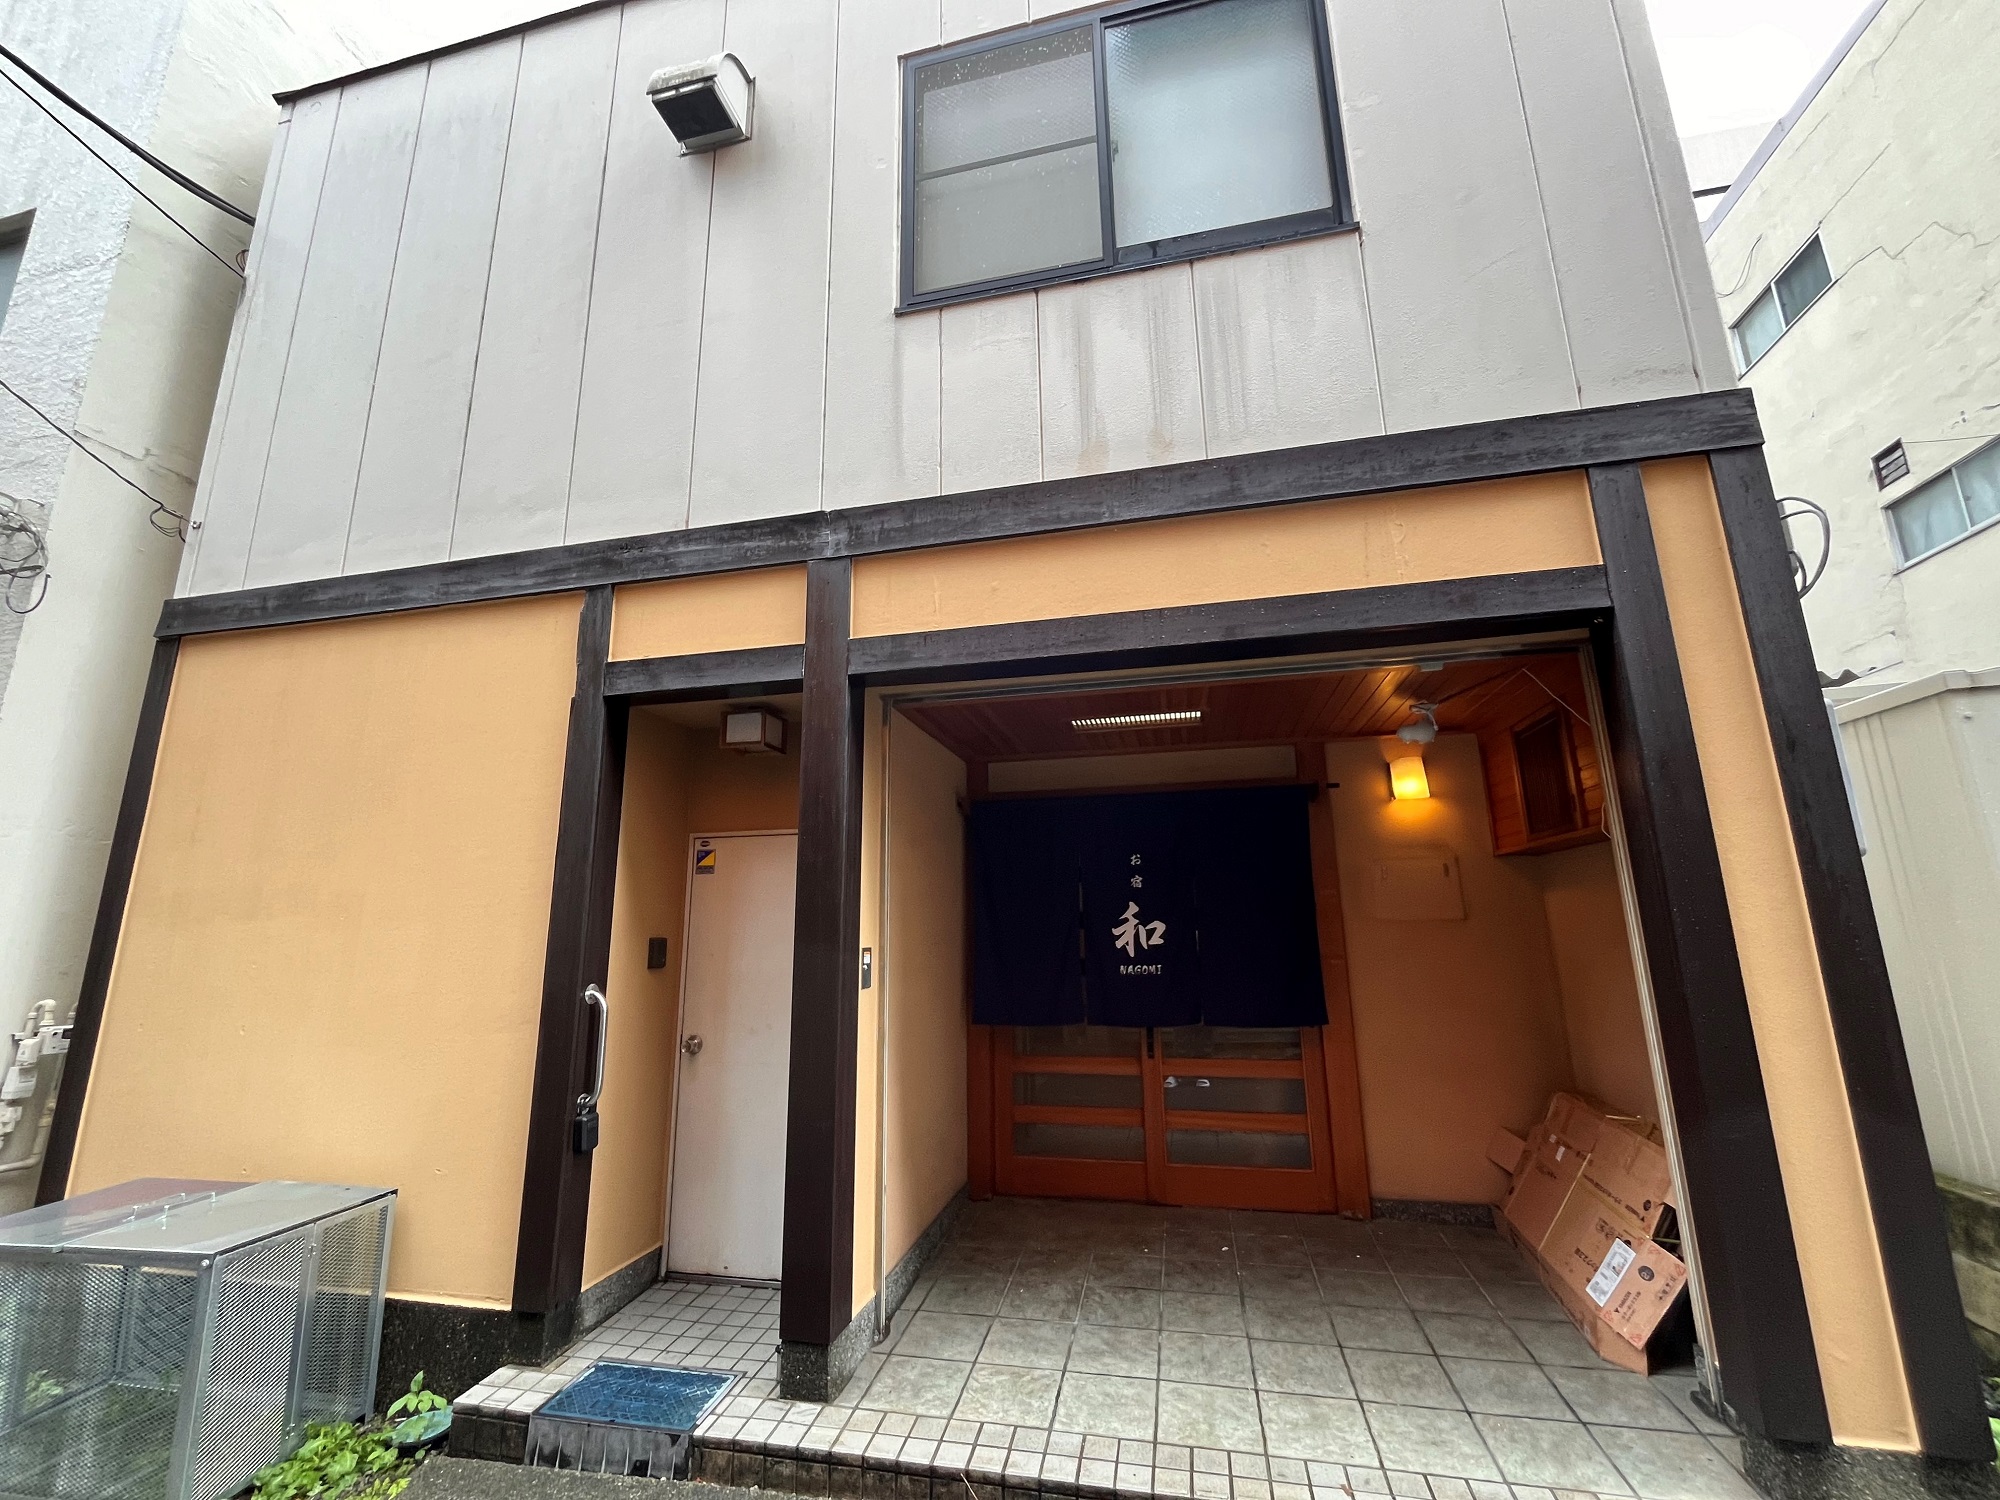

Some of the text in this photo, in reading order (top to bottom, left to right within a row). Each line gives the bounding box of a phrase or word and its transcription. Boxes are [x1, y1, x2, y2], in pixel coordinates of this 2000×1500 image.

[1130, 853, 1143, 888] お宿
[1111, 901, 1167, 958] 和
[1119, 964, 1162, 975] NAGOMI
